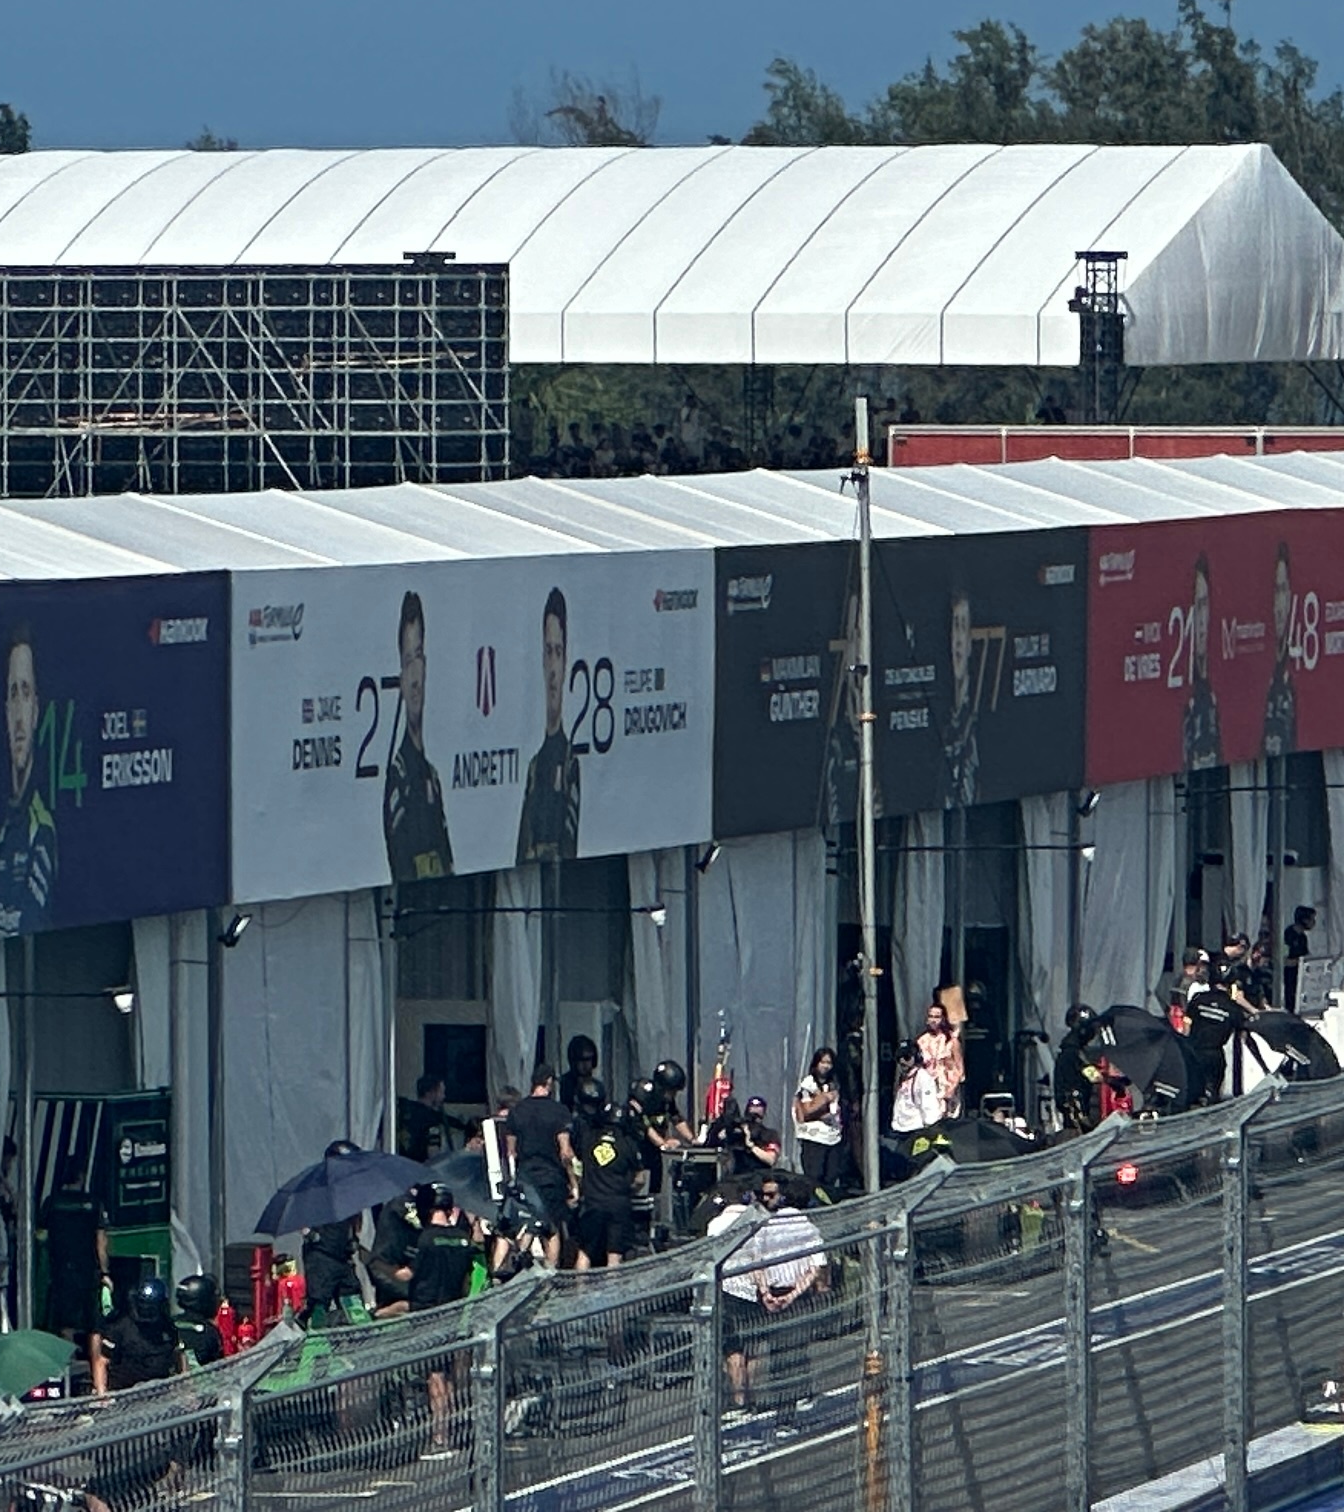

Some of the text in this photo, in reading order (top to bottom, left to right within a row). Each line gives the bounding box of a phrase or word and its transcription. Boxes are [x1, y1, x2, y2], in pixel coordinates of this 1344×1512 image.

[1167, 603, 1196, 688] 21
[1287, 591, 1320, 671] 48
[102, 710, 130, 740] JOEL
[355, 675, 401, 779] 27
[569, 656, 615, 755] 28
[623, 701, 688, 737] DRUGOVICH
[38, 698, 88, 811] 14
[102, 747, 174, 789] ERIKSSON
[292, 735, 343, 771] DENNIS
[452, 747, 520, 790] ANDRETTI
